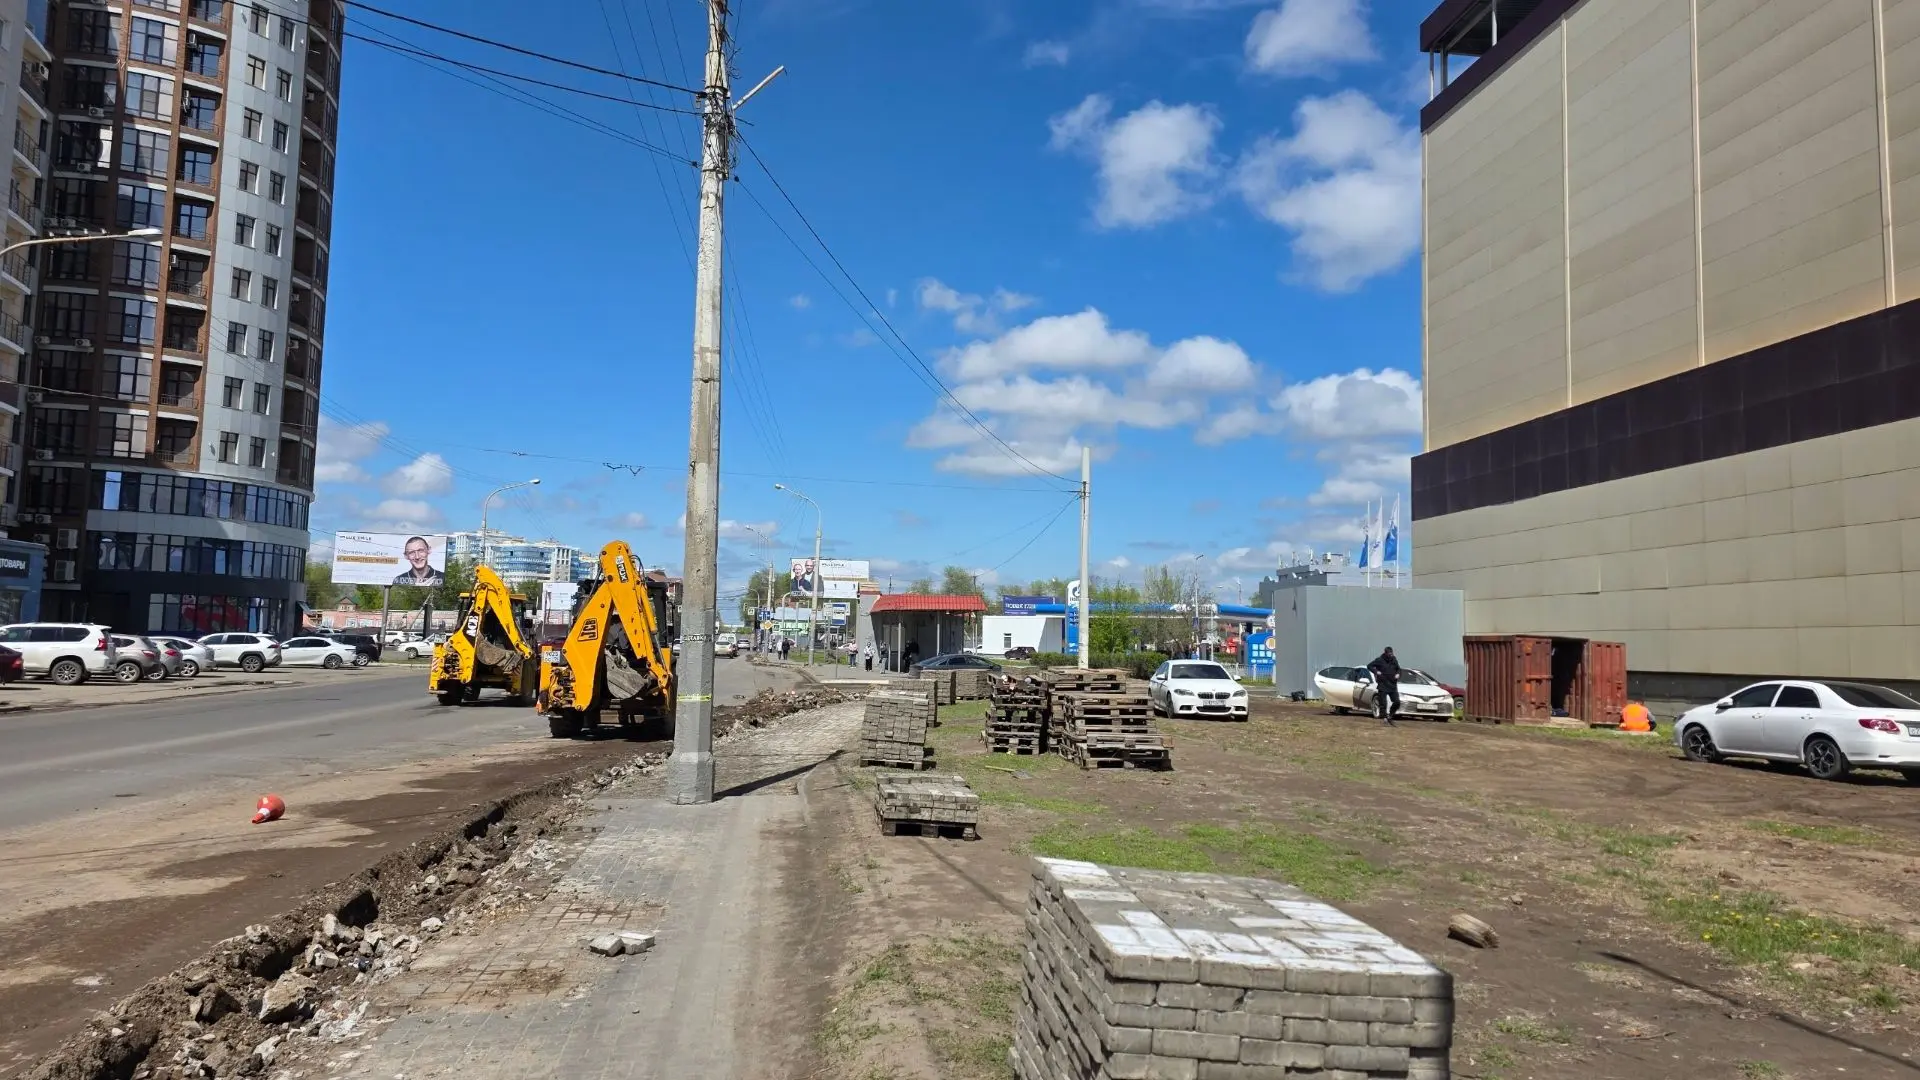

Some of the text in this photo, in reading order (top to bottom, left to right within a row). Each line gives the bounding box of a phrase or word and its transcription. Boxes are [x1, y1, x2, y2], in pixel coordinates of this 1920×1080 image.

[0, 557, 26, 570] ТОВАРЫ
[466, 615, 479, 637] JCB
[579, 619, 598, 639] JCB
